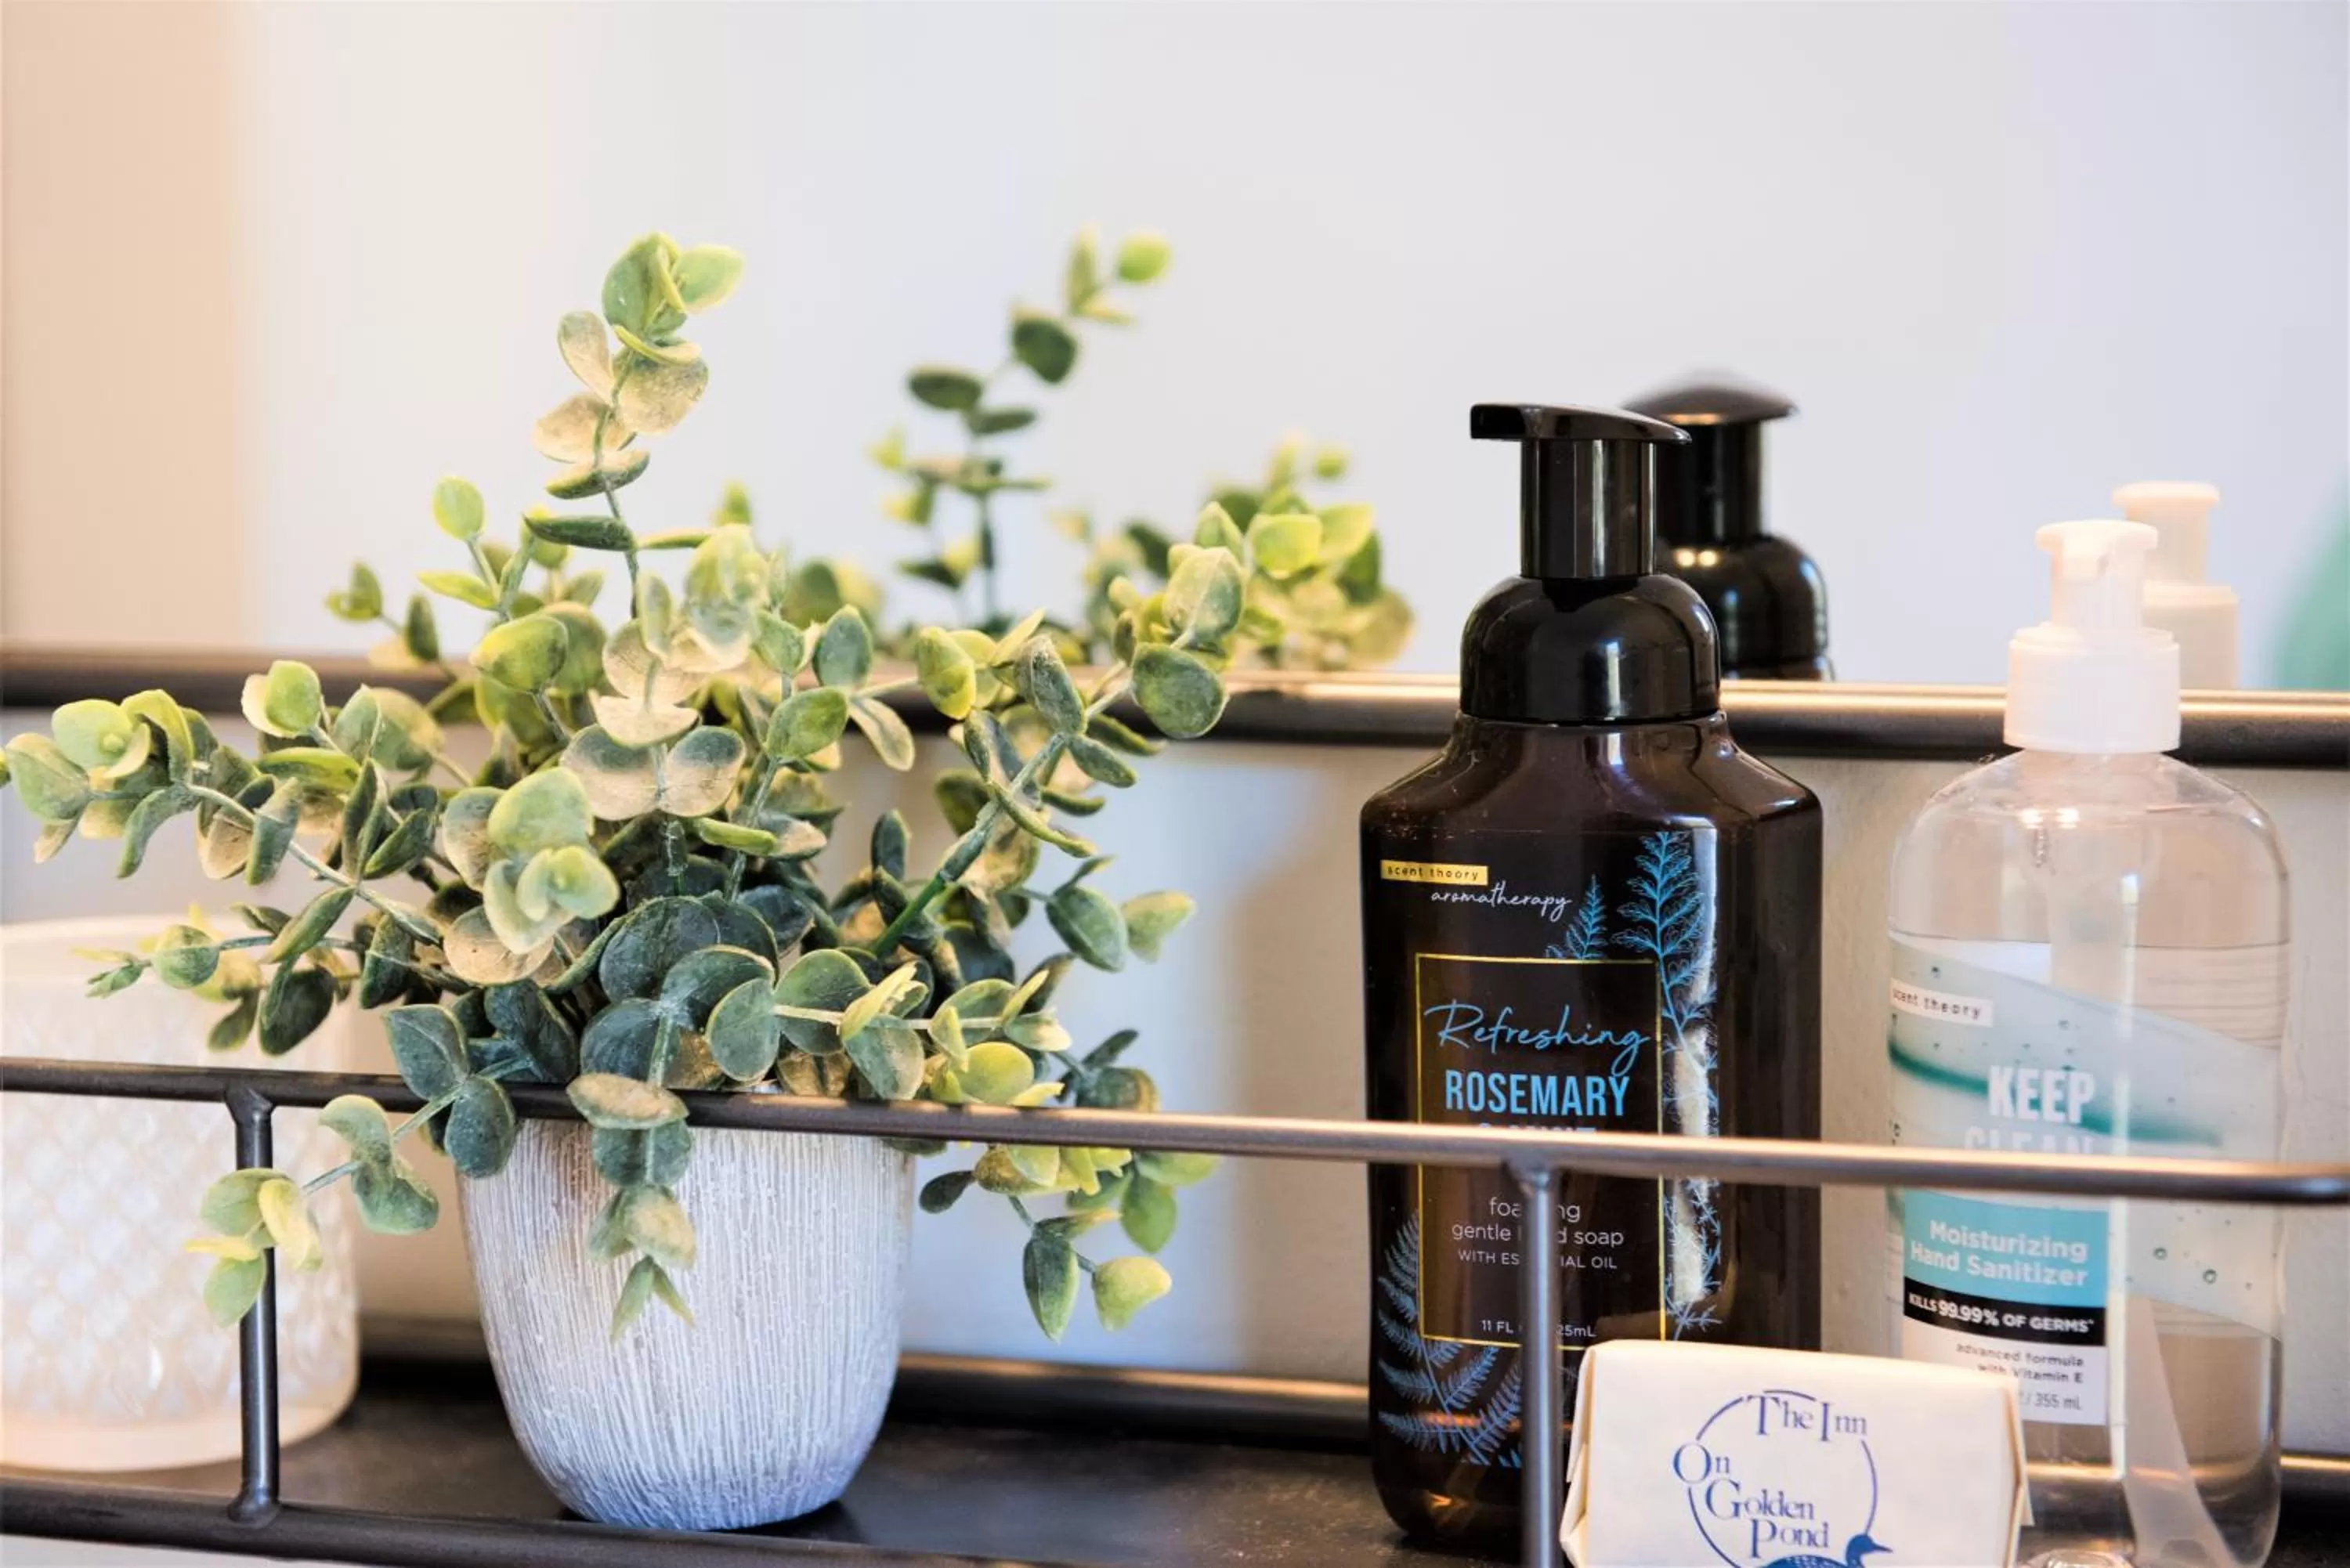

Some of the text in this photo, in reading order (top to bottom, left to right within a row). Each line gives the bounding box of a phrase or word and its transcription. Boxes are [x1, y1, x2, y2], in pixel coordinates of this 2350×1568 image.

[1387, 866, 1479, 881] scent theory
[1430, 880, 1572, 922] aromatherapy
[1424, 999, 1650, 1077] Refreshing
[1444, 1069, 1630, 1116] ROSEMARY
[1986, 1064, 2096, 1124] KEEP
[1490, 1197, 1581, 1223] foang
[1452, 1223, 1511, 1241] gentle
[1574, 1230, 1624, 1248] soap
[1929, 1219, 2088, 1264] Moisturizing
[1458, 1249, 1617, 1269] WITH ESIAL OIL
[1911, 1241, 2088, 1287] Hand Sanitizer
[1481, 1320, 1491, 1331] 11
[1496, 1321, 1514, 1334] FL
[1909, 1292, 1937, 1312] KILLS
[1938, 1299, 1999, 1328] 99.99%
[2002, 1313, 2026, 1328] OF
[1956, 1343, 2084, 1367] advanced formula
[2012, 1368, 2069, 1382] Vitamin
[2074, 1372, 2083, 1383] E
[1744, 1393, 1867, 1442] The Inn
[2035, 1393, 2059, 1407] 355
[1673, 1441, 1730, 1484] On
[1705, 1478, 1814, 1520] Golden
[1749, 1518, 1829, 1558] Pond
